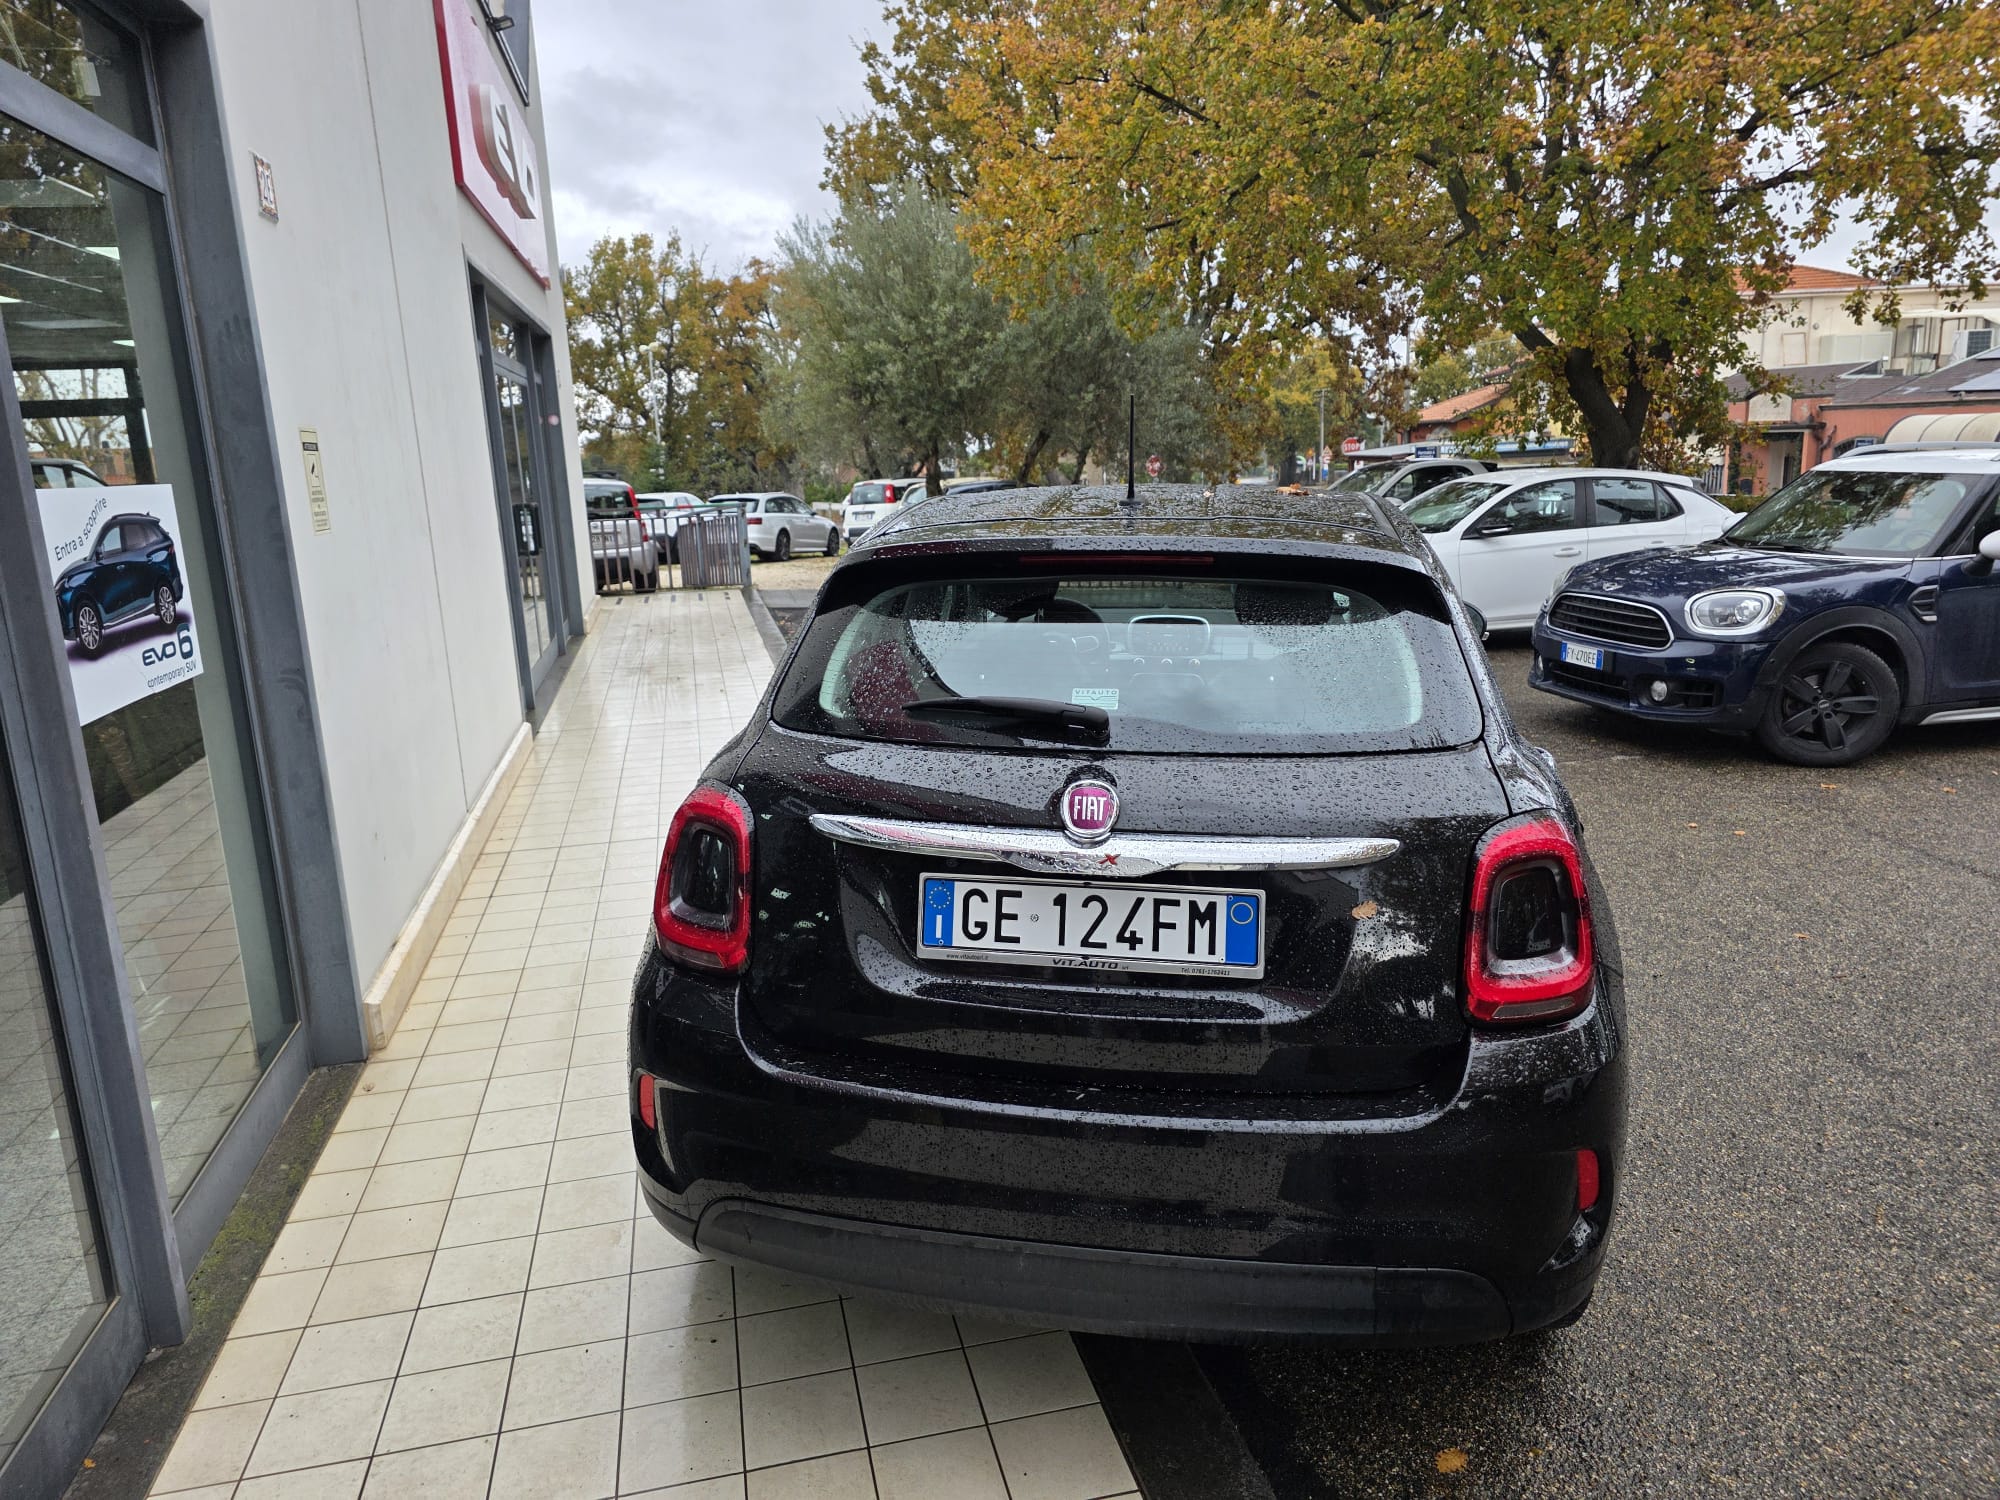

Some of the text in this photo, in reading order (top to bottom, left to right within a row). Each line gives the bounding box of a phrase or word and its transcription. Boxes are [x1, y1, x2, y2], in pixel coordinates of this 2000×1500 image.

[54, 498, 107, 561] Entra a scoprire
[176, 623, 194, 660] 6
[147, 660, 197, 688] contemporary SUV
[1073, 795, 1107, 821] FIAT
[961, 888, 1217, 956] GE 124FM
